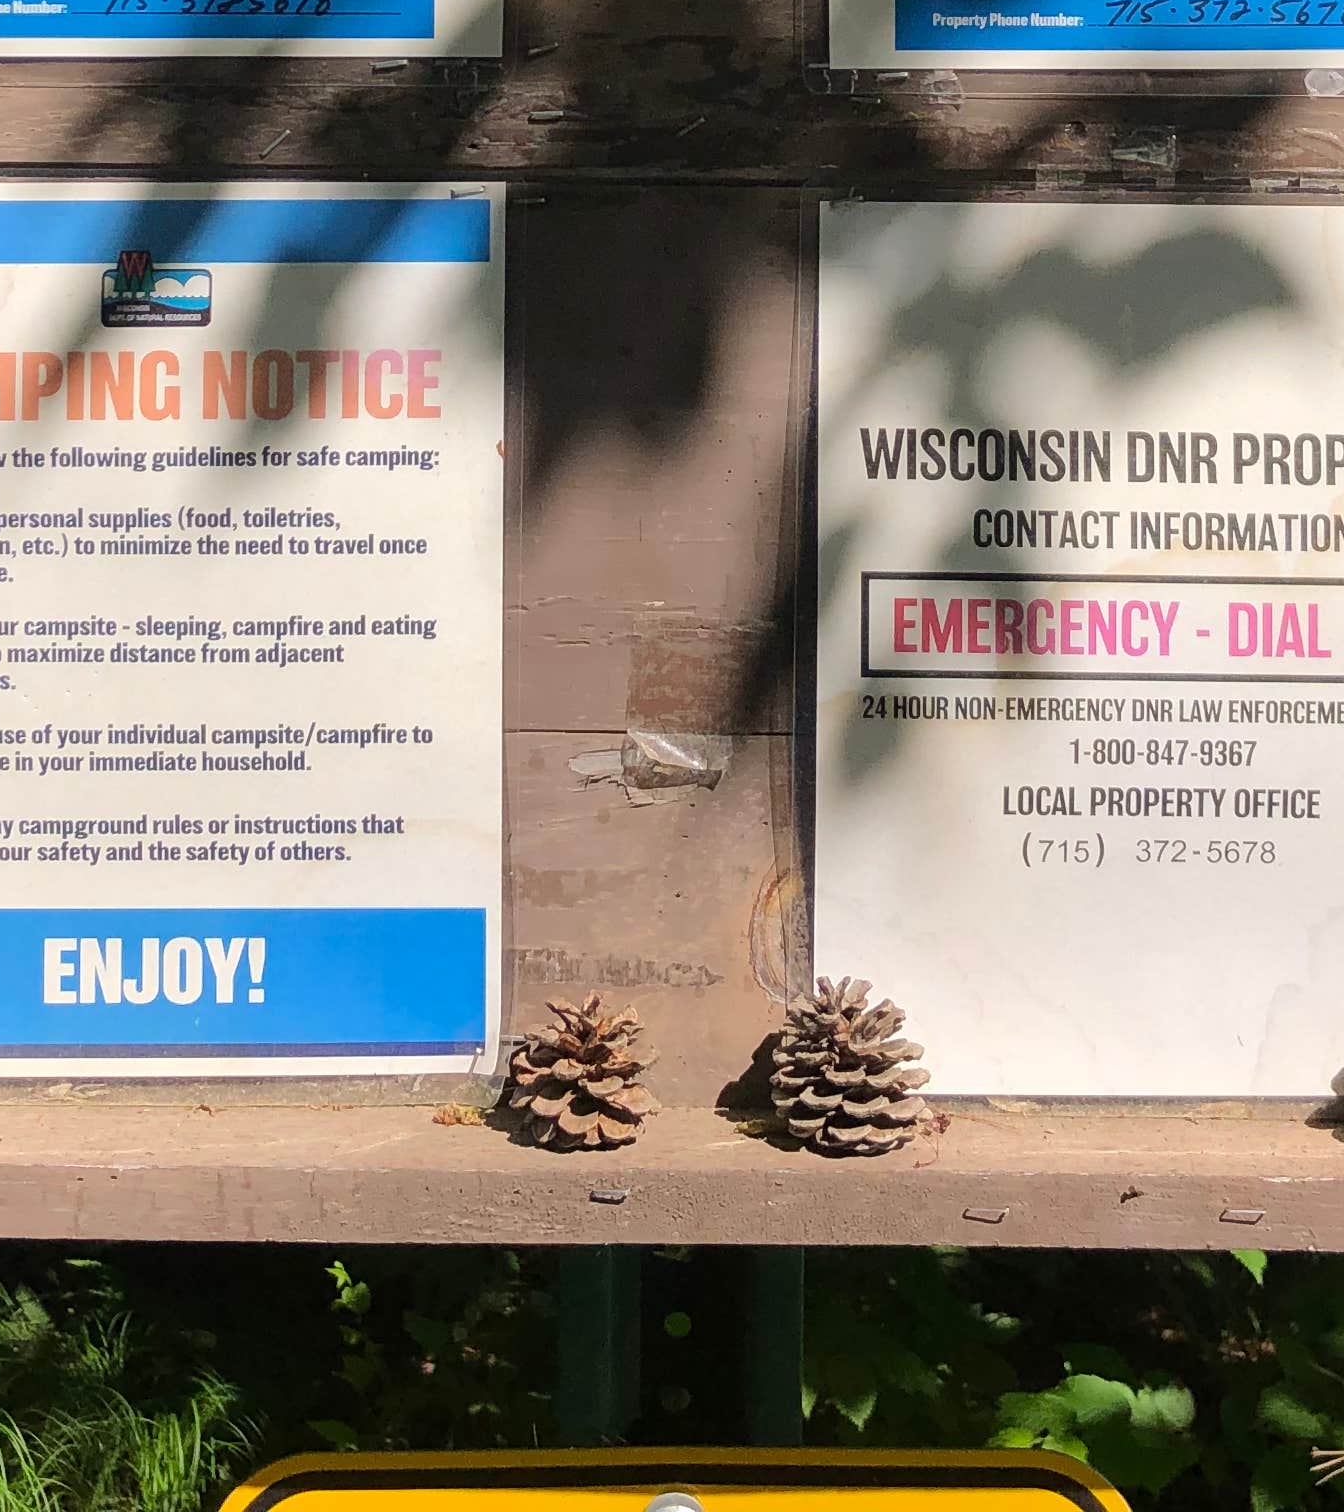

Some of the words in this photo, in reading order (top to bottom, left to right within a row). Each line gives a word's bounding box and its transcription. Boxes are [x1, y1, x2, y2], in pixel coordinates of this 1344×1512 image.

[12, 0, 67, 14] Number:
[933, 13, 987, 29] Property
[990, 13, 1028, 26] Phone
[1031, 13, 1083, 26] Number:
[203, 350, 440, 419] NOTICE
[12, 448, 44, 467] the
[50, 447, 147, 472] following
[152, 447, 256, 472] guidelines
[262, 446, 291, 466] for
[297, 446, 340, 466] safe
[346, 445, 439, 470] camping:
[860, 422, 1110, 482] WISCONSIN
[1128, 432, 1217, 484] DNR
[89, 508, 171, 533] supplies
[178, 506, 237, 531] (food,
[243, 507, 340, 530] toiletries,
[973, 509, 1120, 549] CONTACT
[894, 598, 1178, 656] EMERGENCY
[1229, 603, 1331, 658] DIAL
[863, 695, 887, 718] 24
[894, 696, 948, 719] HOUR
[955, 697, 1125, 721] NON-EMERGENCY
[1133, 699, 1172, 722] DNR
[1180, 700, 1222, 722] LAW
[1070, 739, 1256, 766] 1-800-847-9367
[1004, 786, 1081, 815] LOCAL
[1091, 787, 1226, 817] PROPERTY
[1235, 789, 1320, 818] OFFICE
[19, 815, 147, 839] campground
[153, 815, 203, 834] rules
[209, 820, 229, 834] or
[235, 814, 356, 834] instructions
[362, 814, 404, 834] that
[1023, 832, 1104, 867] (715)
[1136, 840, 1275, 863] 372-5678
[44, 937, 265, 1005] ENJOY!
